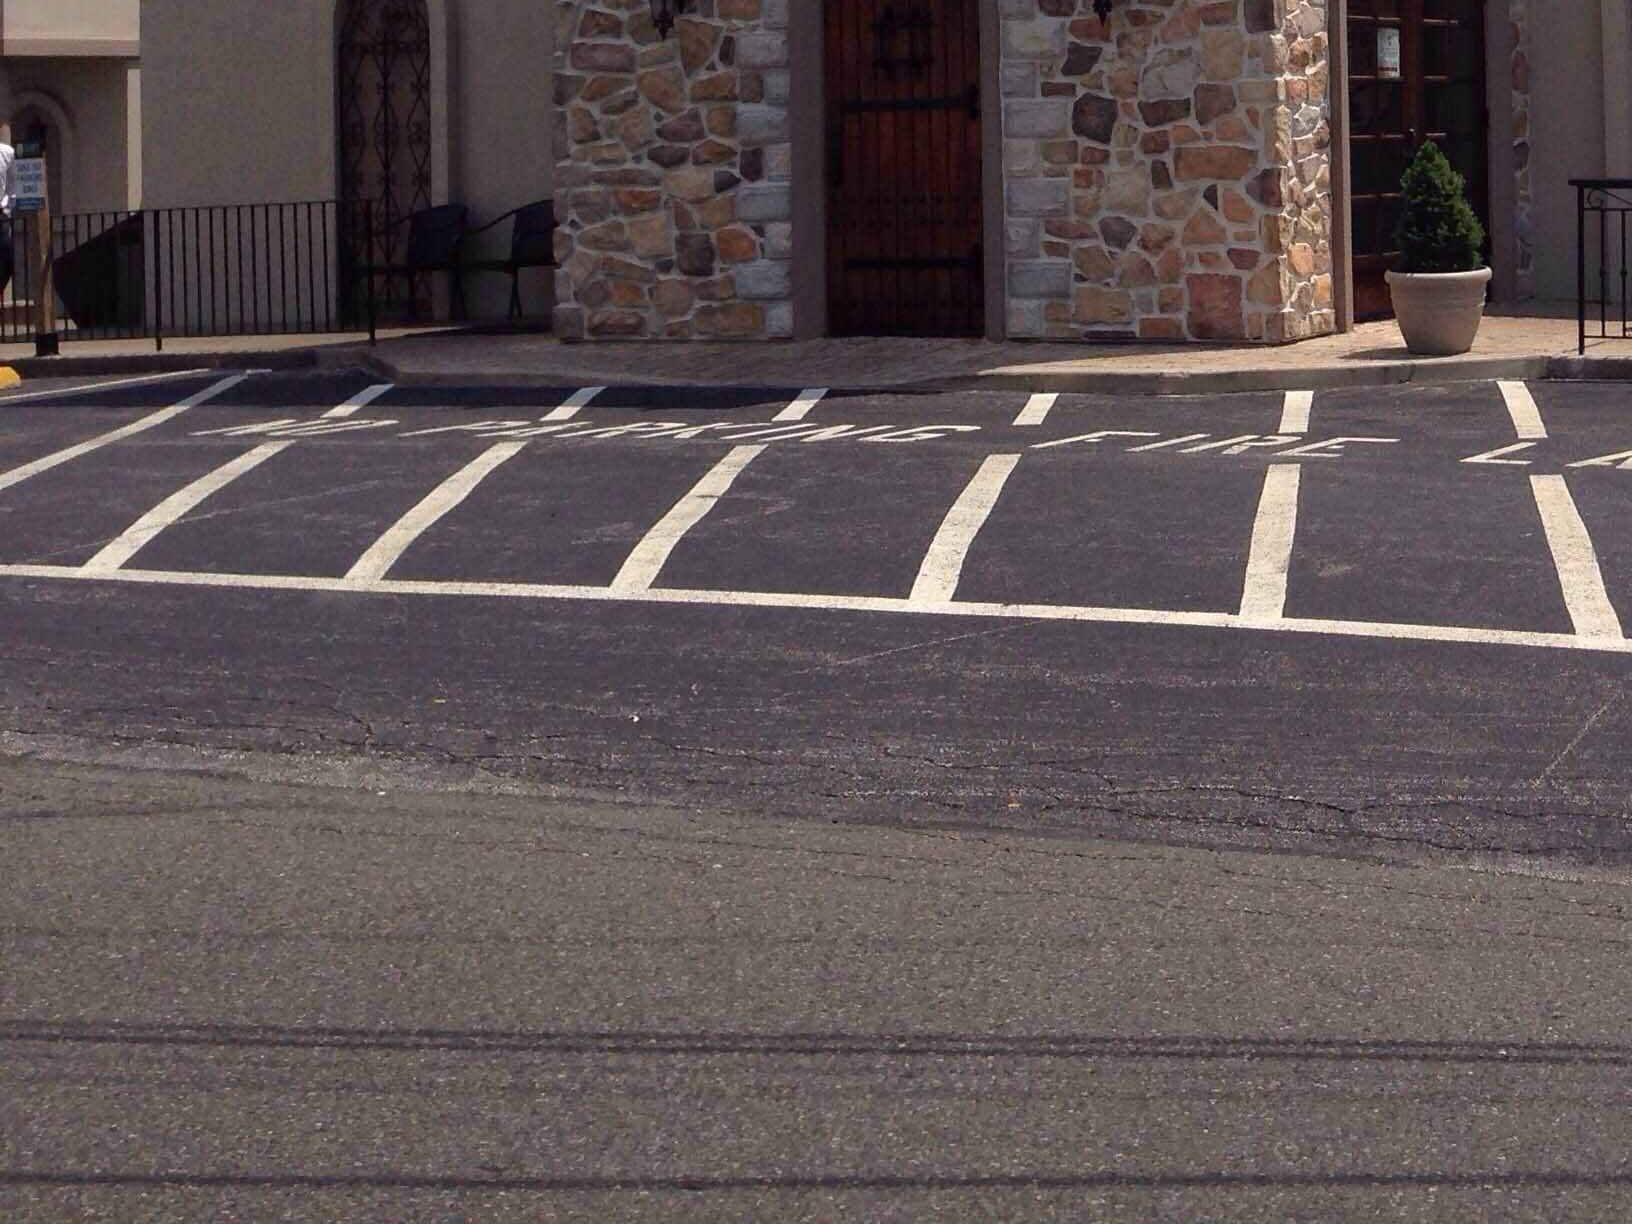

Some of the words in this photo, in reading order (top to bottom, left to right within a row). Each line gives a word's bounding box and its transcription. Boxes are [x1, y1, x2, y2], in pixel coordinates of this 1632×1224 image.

[187, 419, 401, 438] NO
[397, 420, 982, 442] PARKING
[1028, 431, 1401, 457] FIRE
